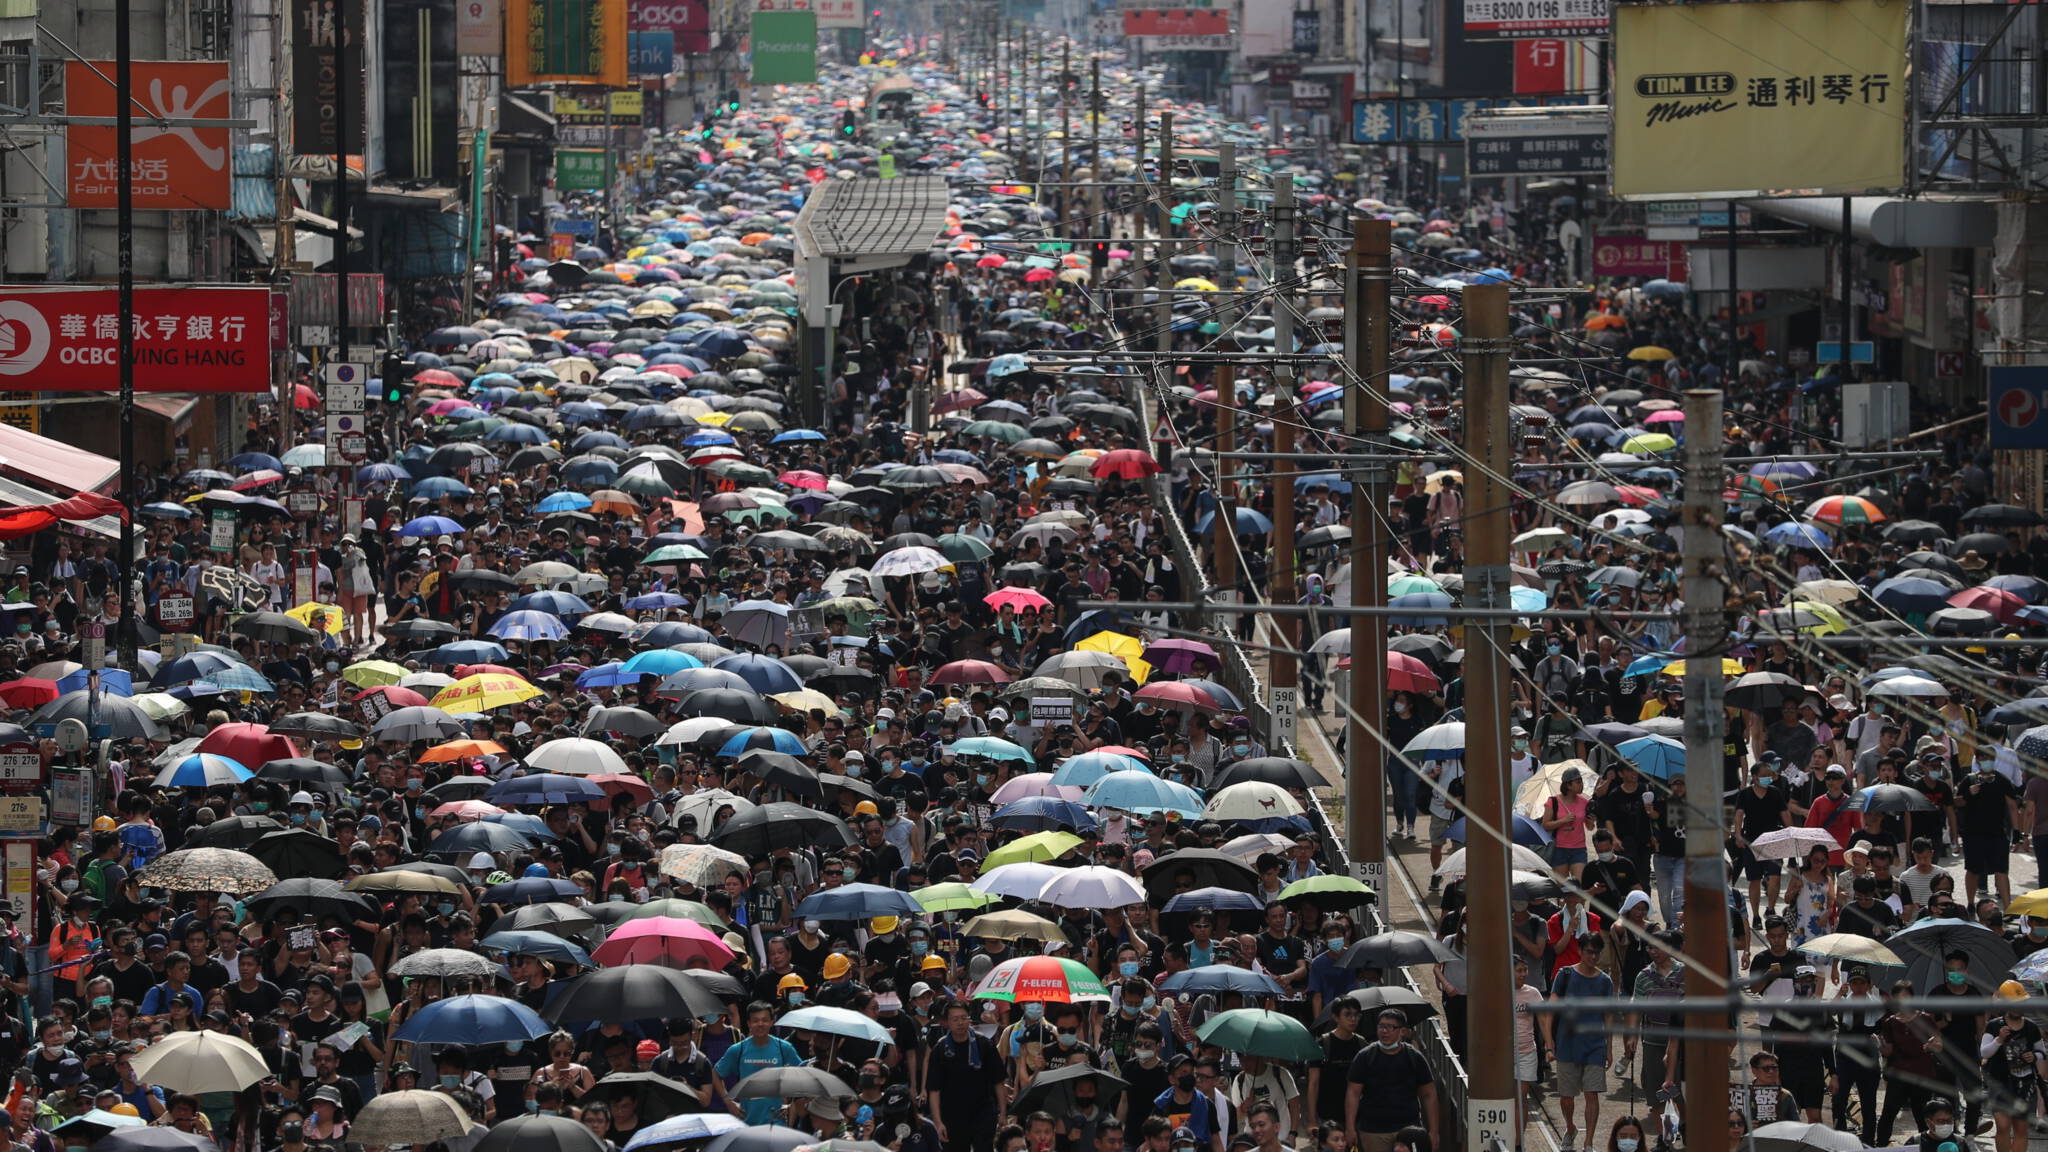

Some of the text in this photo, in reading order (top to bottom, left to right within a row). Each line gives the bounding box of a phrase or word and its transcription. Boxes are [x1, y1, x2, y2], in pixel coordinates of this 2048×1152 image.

[1492, 2, 1523, 19] 8300
[1528, 1, 1559, 18] 0196
[628, 48, 663, 64] ank
[1529, 40, 1558, 66] 行
[1644, 75, 1729, 94] TOM LEE
[1747, 74, 1890, 108] 通利琴行
[1646, 97, 1738, 127] Music
[1580, 157, 1607, 169] 耳鼻
[75, 184, 168, 195] Fairood
[60, 314, 246, 343] 華僑永亨銀行
[60, 347, 117, 365] OCBC
[184, 350, 245, 366] HANG
[353, 387, 360, 395] 7
[353, 401, 363, 410] 12
[1275, 691, 1294, 701] 590
[1276, 705, 1292, 714] PL
[1279, 718, 1291, 728] 18
[3, 756, 17, 766] 276
[5, 768, 15, 777] B1
[1360, 863, 1383, 875] 590
[1478, 1109, 1507, 1124] 590
